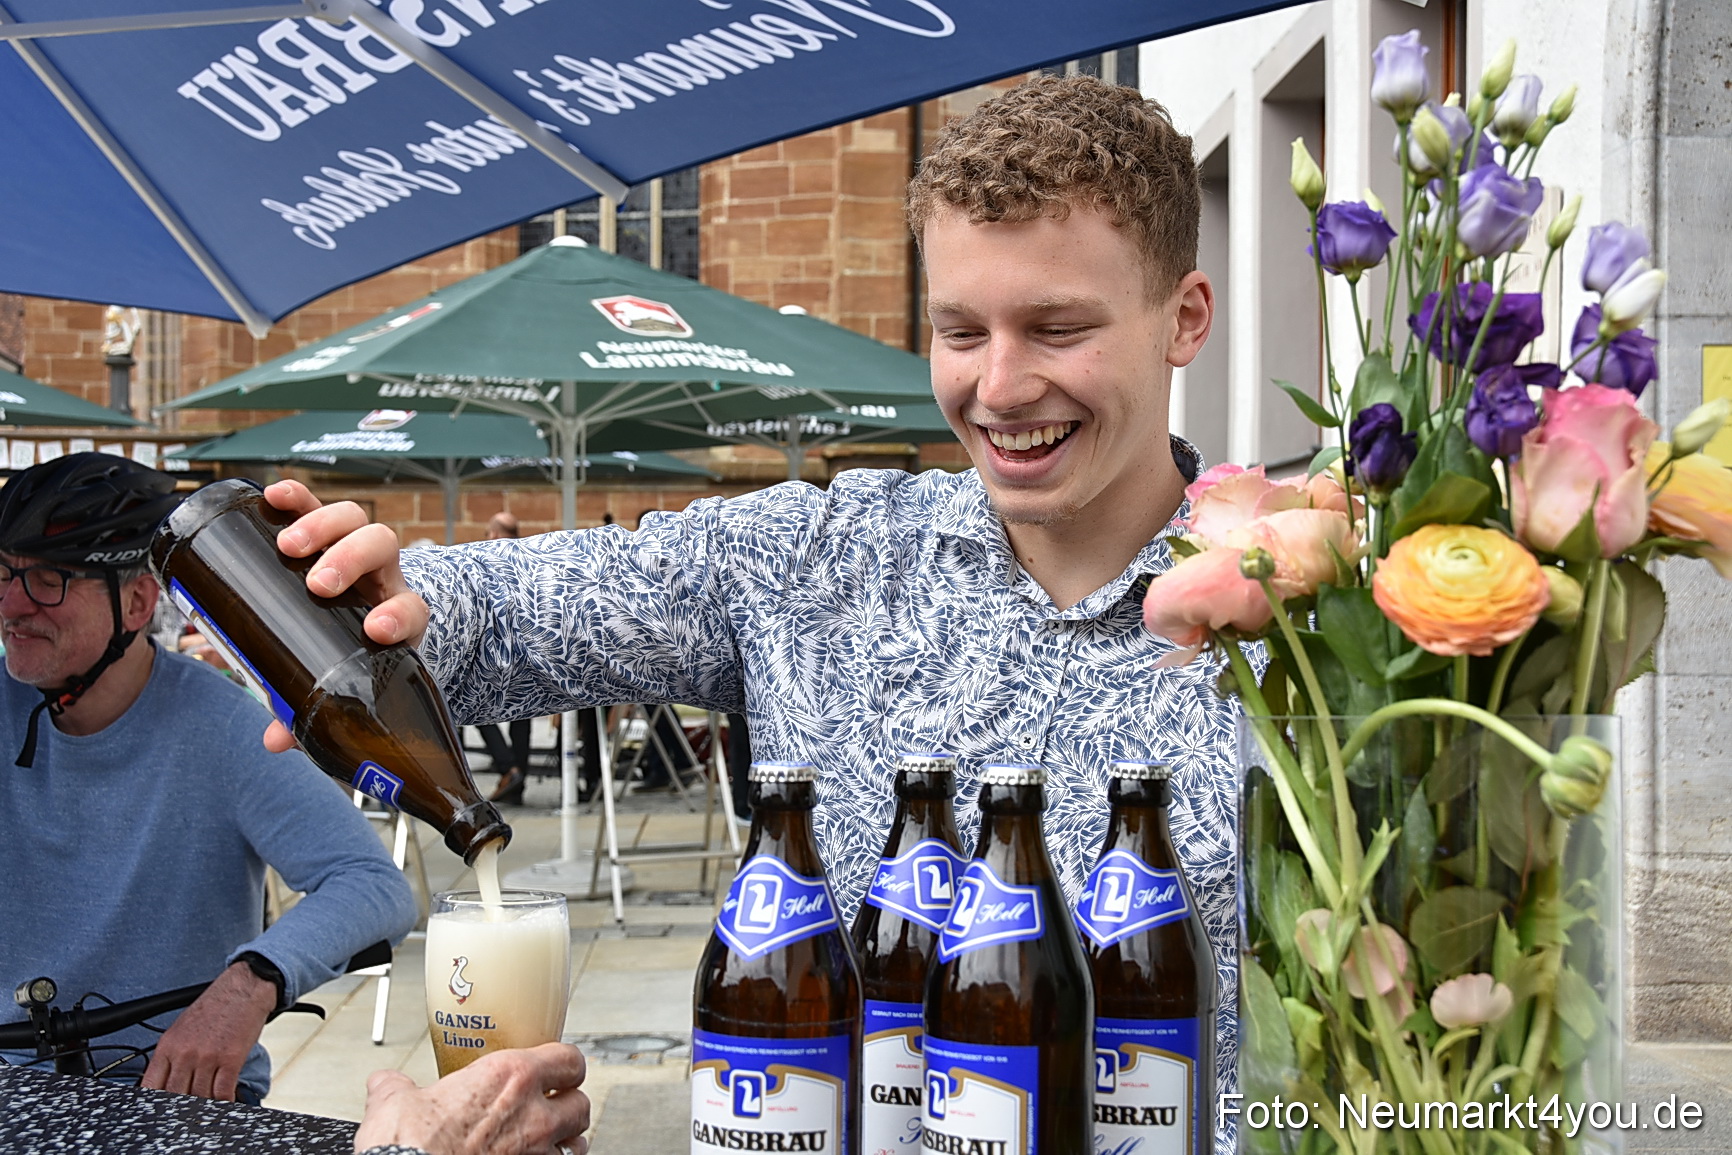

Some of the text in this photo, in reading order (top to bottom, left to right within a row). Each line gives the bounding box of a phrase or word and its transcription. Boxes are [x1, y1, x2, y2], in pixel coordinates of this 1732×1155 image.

[84, 546, 150, 563] RUDY
[873, 871, 914, 894] Hell
[781, 892, 826, 920] Hell
[1132, 884, 1178, 909] Hell
[975, 901, 1031, 925] Hell
[435, 1010, 496, 1030] GANSL
[443, 1030, 485, 1049] Limo
